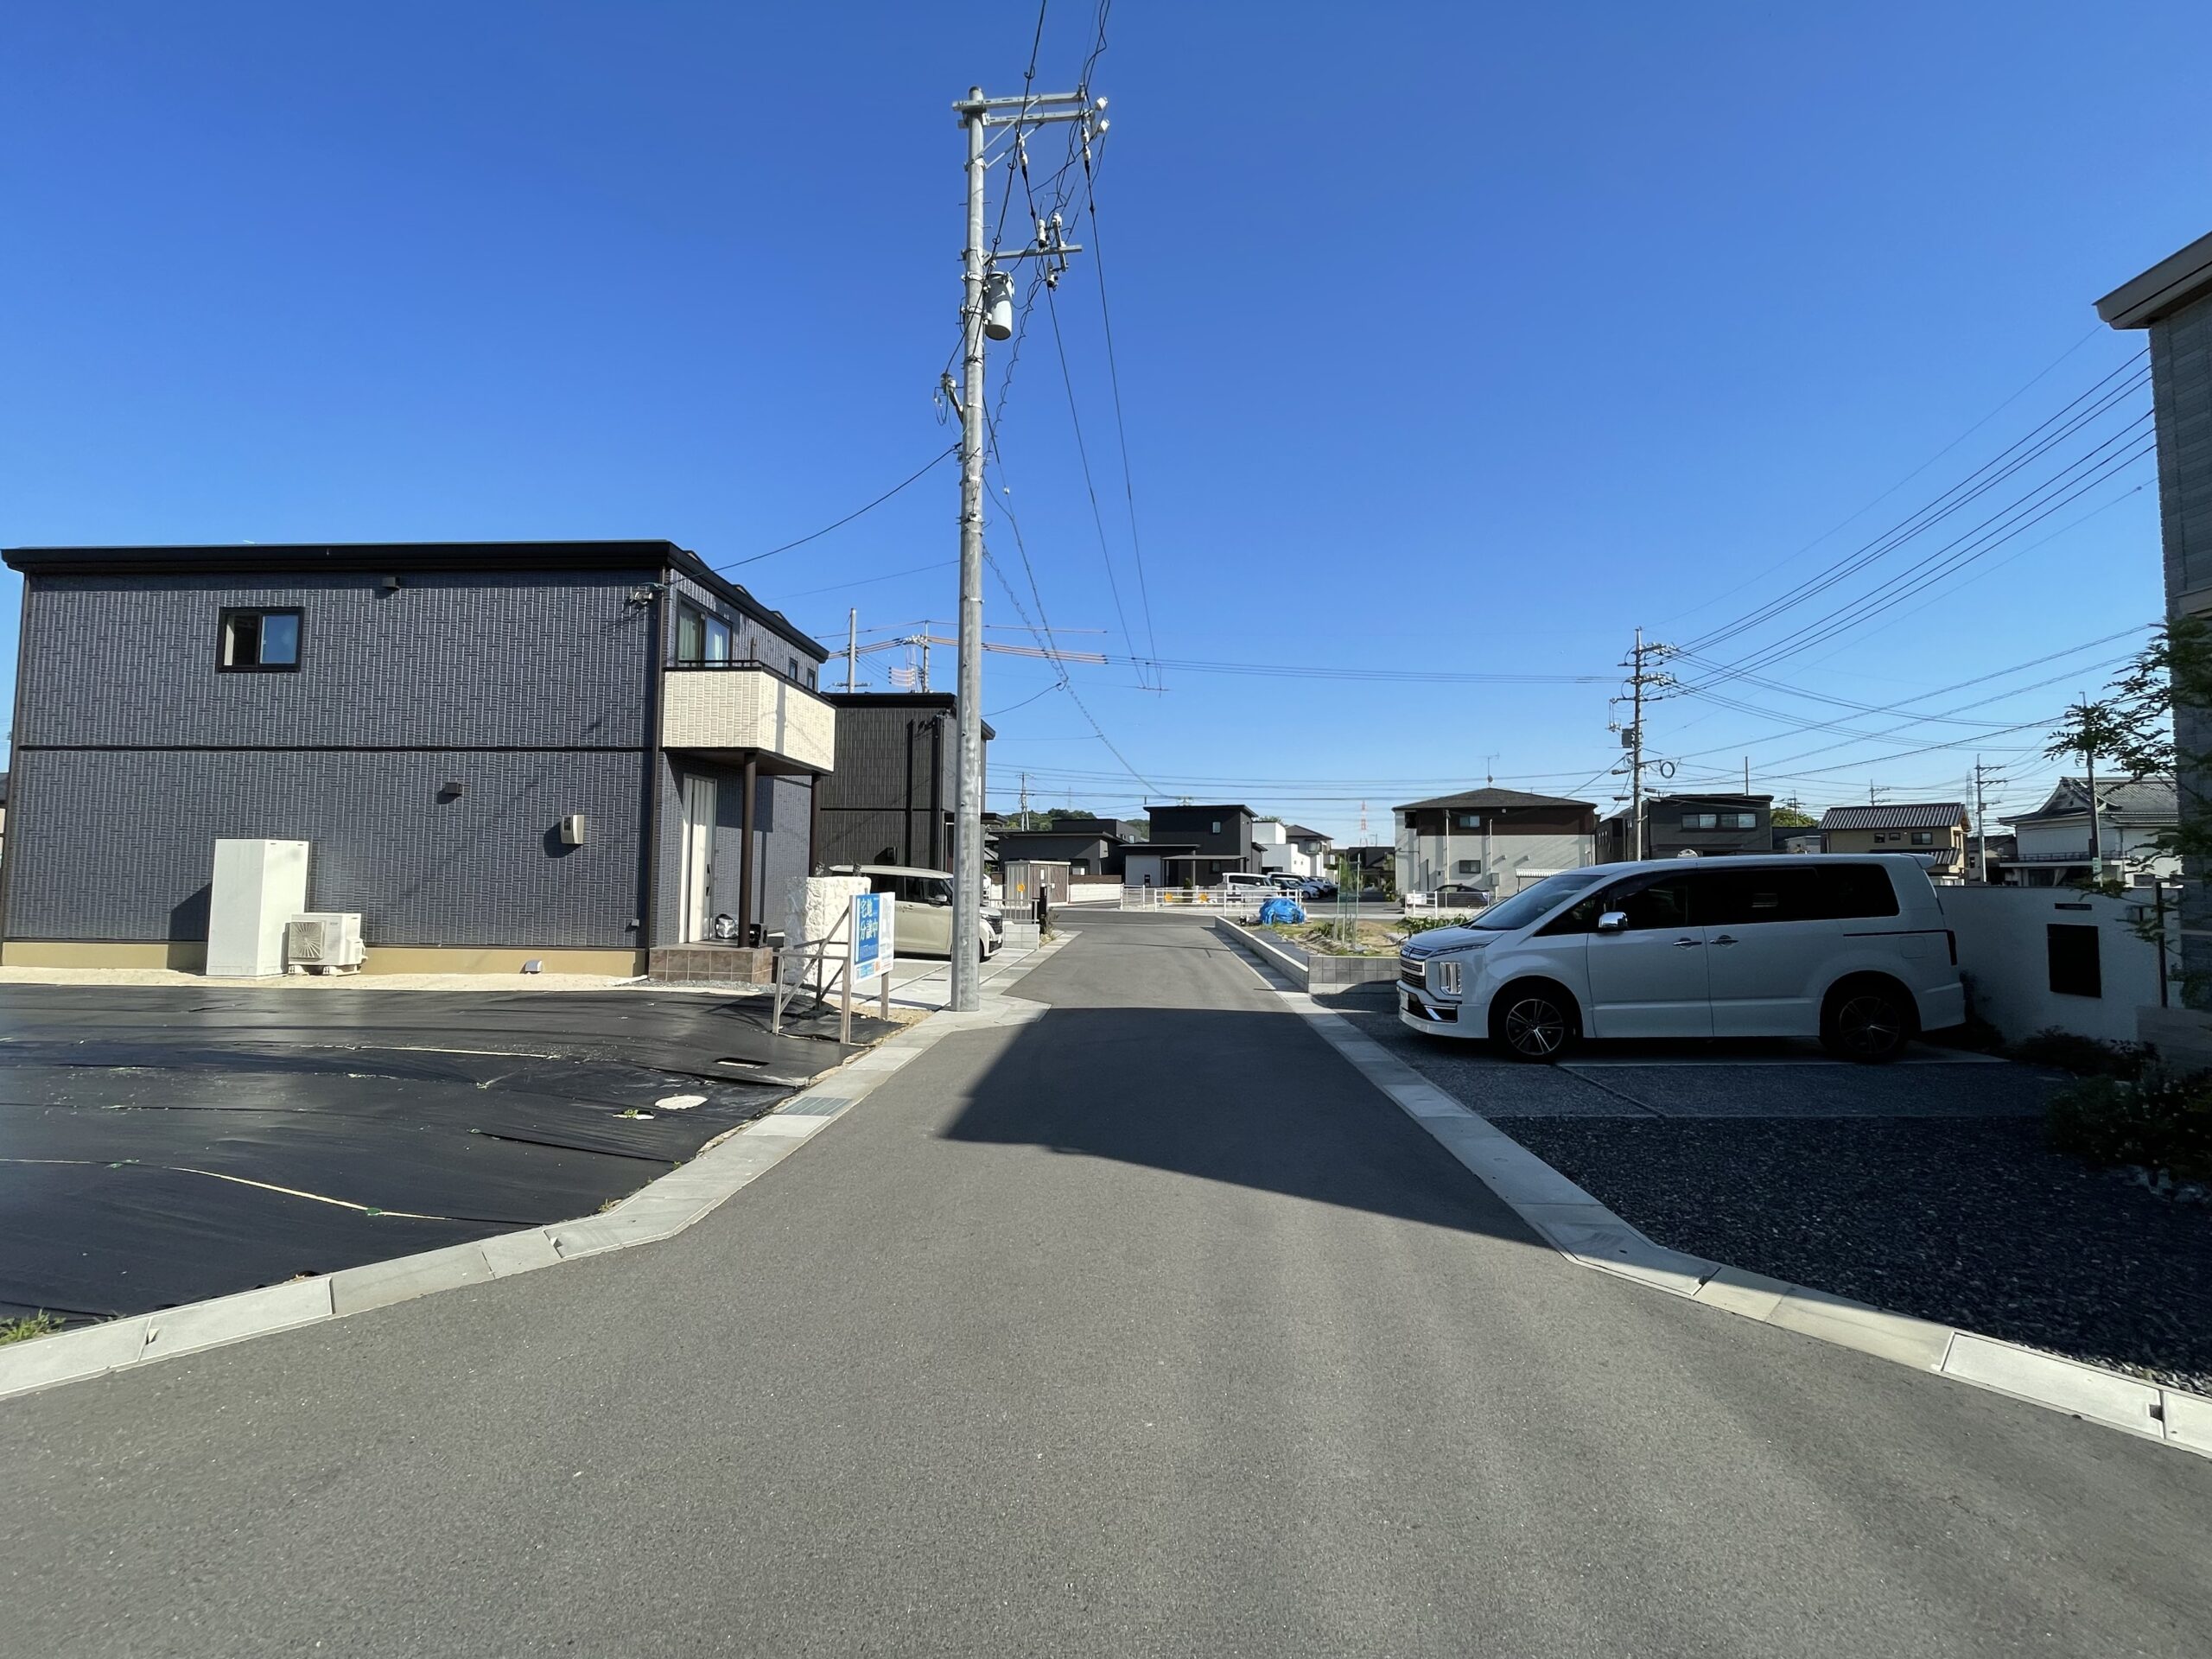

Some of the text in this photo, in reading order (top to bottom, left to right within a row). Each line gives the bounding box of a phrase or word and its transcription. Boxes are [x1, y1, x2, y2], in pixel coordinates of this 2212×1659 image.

[860, 898, 873, 918] 宅地
[860, 918, 878, 941] 分譲中
